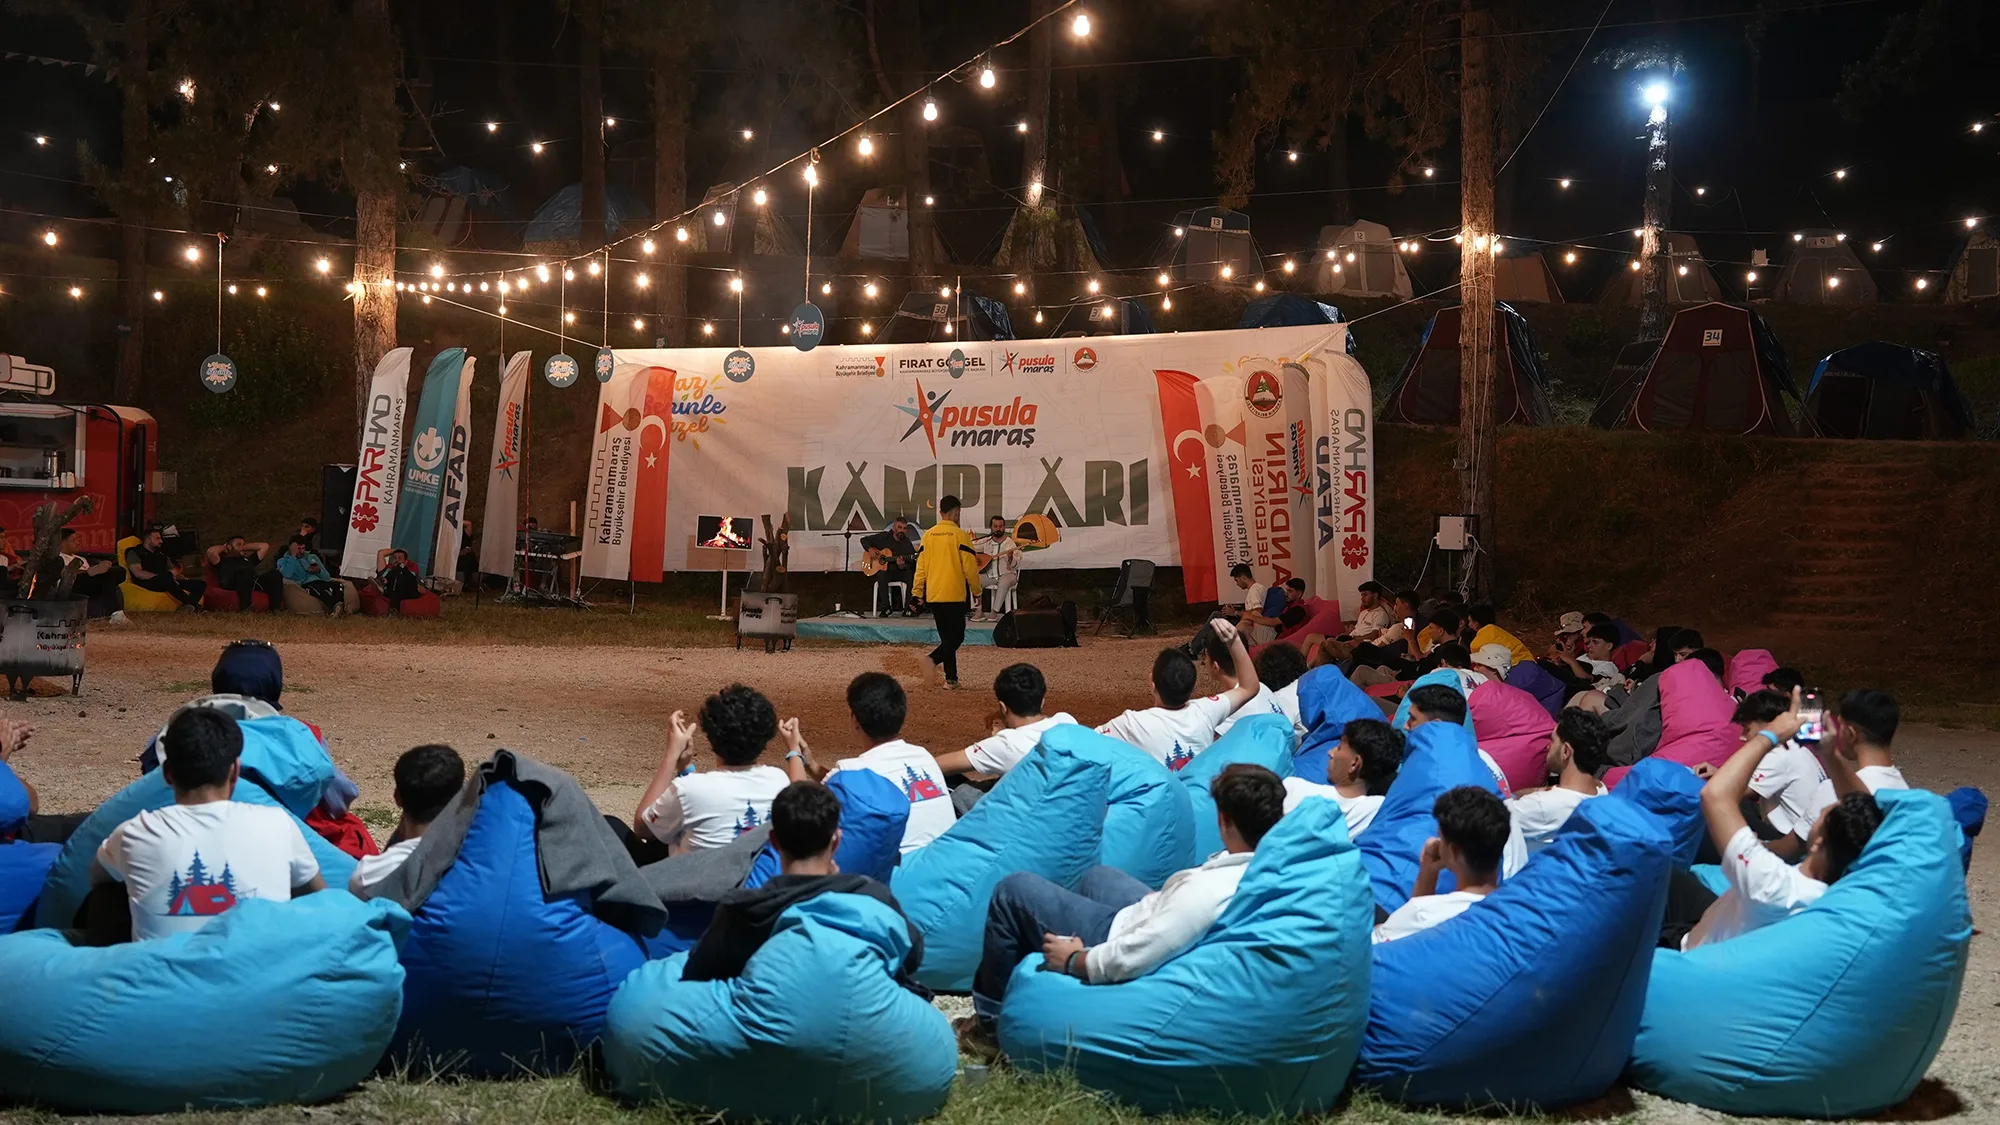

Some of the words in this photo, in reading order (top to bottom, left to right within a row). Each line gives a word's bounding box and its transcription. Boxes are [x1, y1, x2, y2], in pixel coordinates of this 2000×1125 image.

[934, 305, 947, 314] 38
[1705, 331, 1721, 341] 34
[899, 358, 934, 369] FIRAT
[936, 357, 986, 368] GGEL
[1018, 354, 1056, 370] pusula
[1022, 366, 1055, 374] maraş
[674, 376, 708, 400] az
[504, 401, 516, 459] pusula
[511, 403, 522, 453] maraş
[937, 396, 1039, 438] pusula
[951, 427, 1036, 449] maraş
[383, 397, 404, 505] KAHRAMANMARAŞ
[617, 437, 631, 487] Belediyesi
[407, 468, 441, 486] UMKE
[444, 424, 467, 530] AFAD
[598, 437, 623, 545] Kahramanmaraş
[787, 456, 1149, 531] KAMPLARI
[611, 491, 627, 546] Büyükşehir
